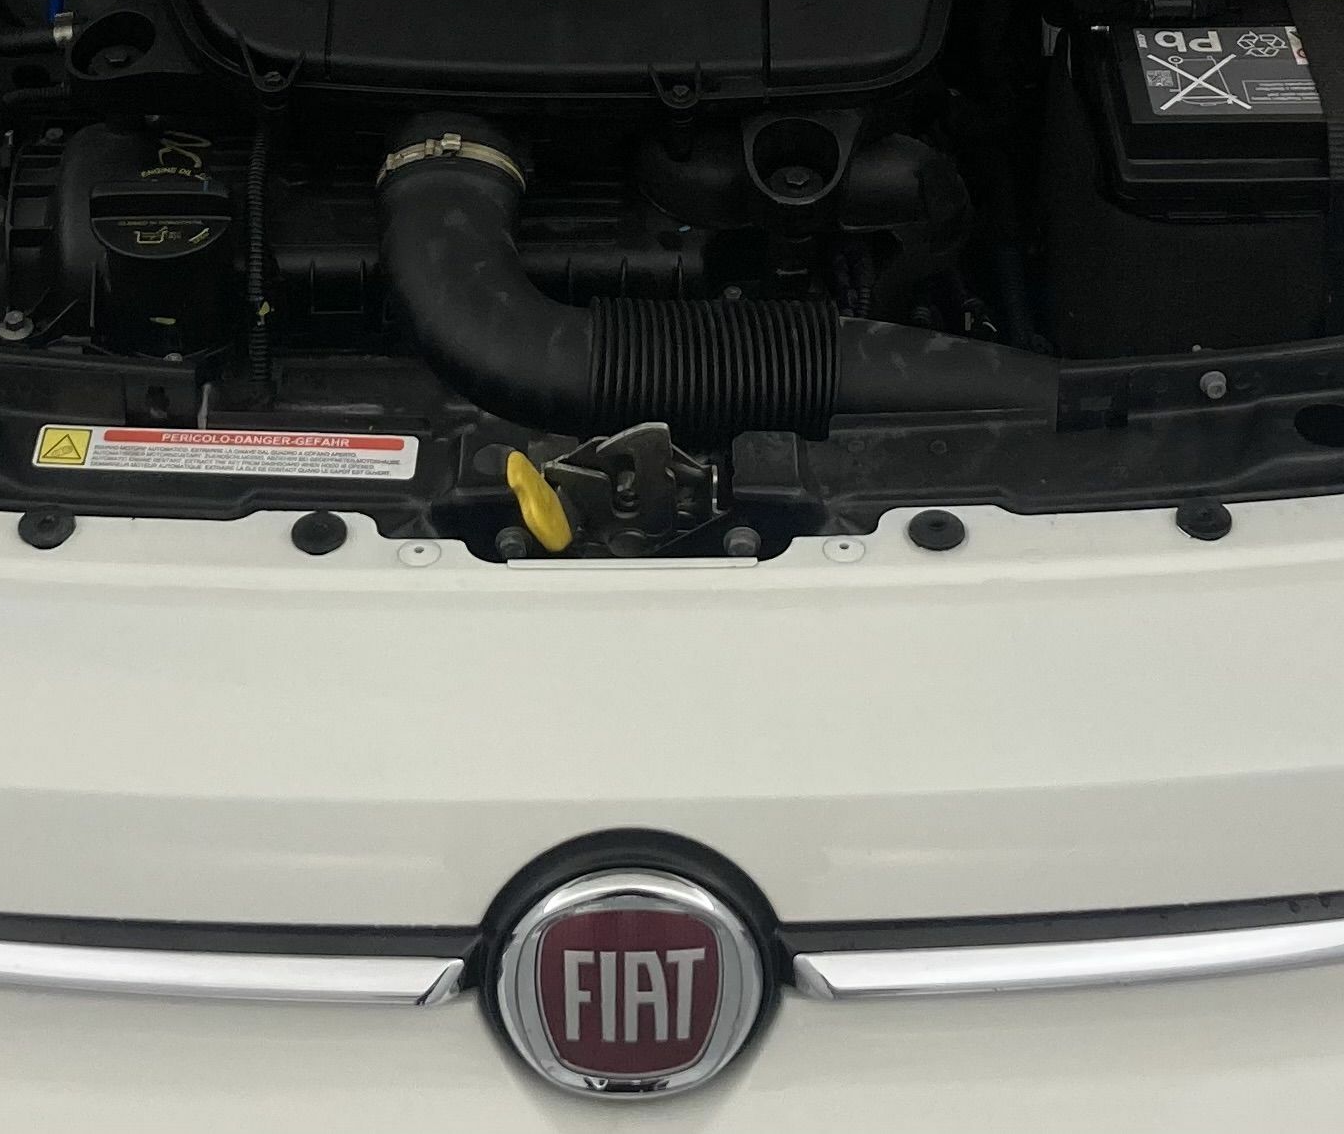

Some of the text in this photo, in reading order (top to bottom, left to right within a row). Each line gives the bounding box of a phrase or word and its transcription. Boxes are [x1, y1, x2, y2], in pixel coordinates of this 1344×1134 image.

[1154, 30, 1223, 54] Pb
[161, 433, 350, 447] PERICOLO-DANGER-GEFAHR
[564, 948, 705, 1043] FIAT
